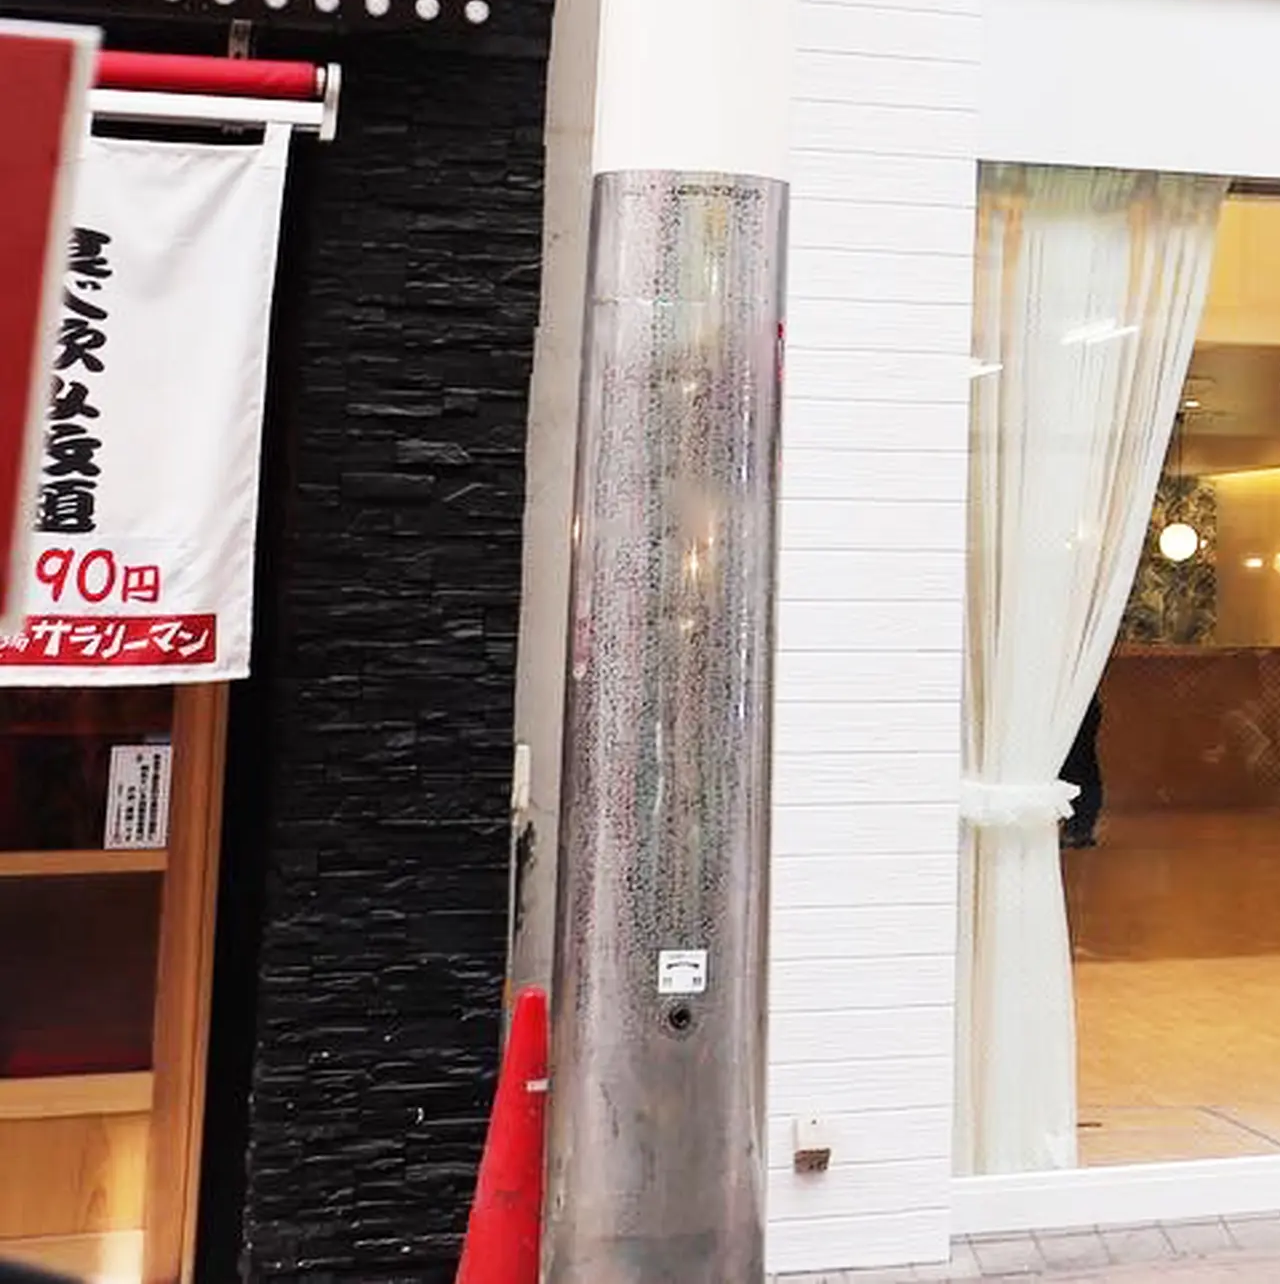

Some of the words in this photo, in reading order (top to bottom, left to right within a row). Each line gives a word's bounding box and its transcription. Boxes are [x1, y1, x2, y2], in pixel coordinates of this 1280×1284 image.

[30, 618, 210, 660] サラリーマン
